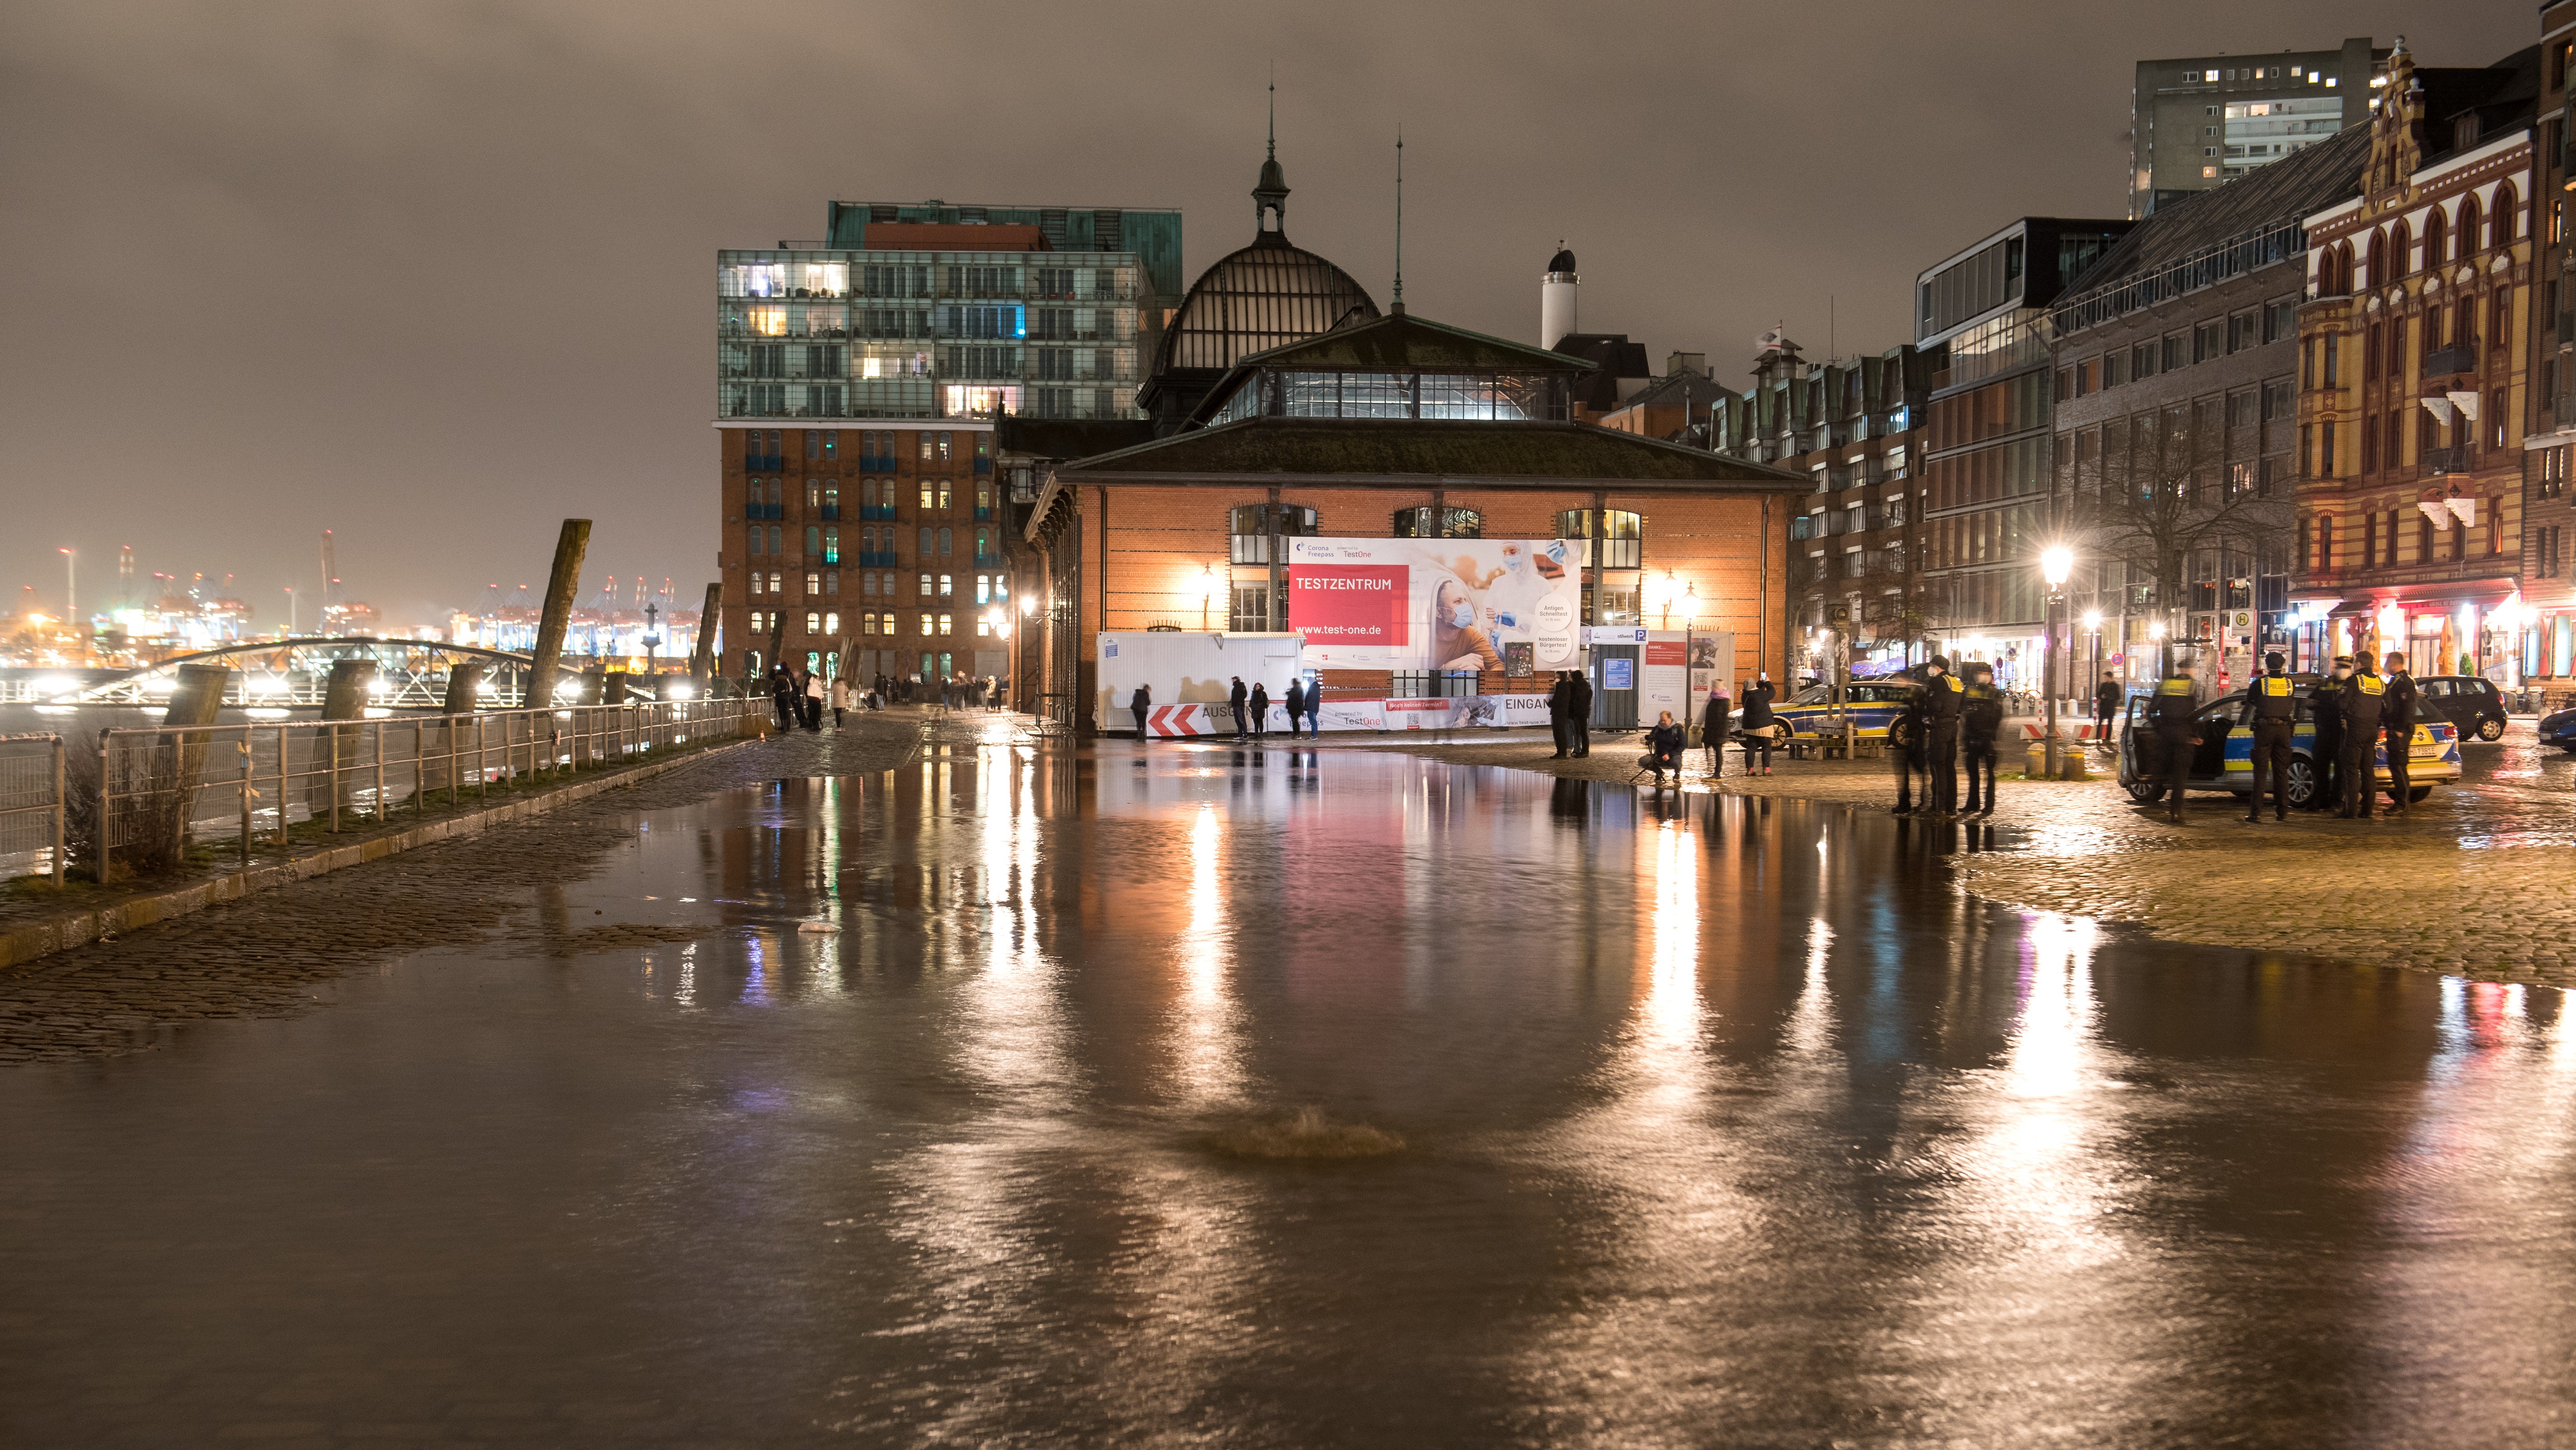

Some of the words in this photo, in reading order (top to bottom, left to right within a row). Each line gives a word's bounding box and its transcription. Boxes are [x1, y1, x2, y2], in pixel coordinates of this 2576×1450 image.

[1296, 578, 1391, 590] TESTZENTRUM
[1296, 625, 1381, 635] www.test-one.de
[1637, 631, 1644, 640] P
[1505, 699, 1552, 709] EINGAN
